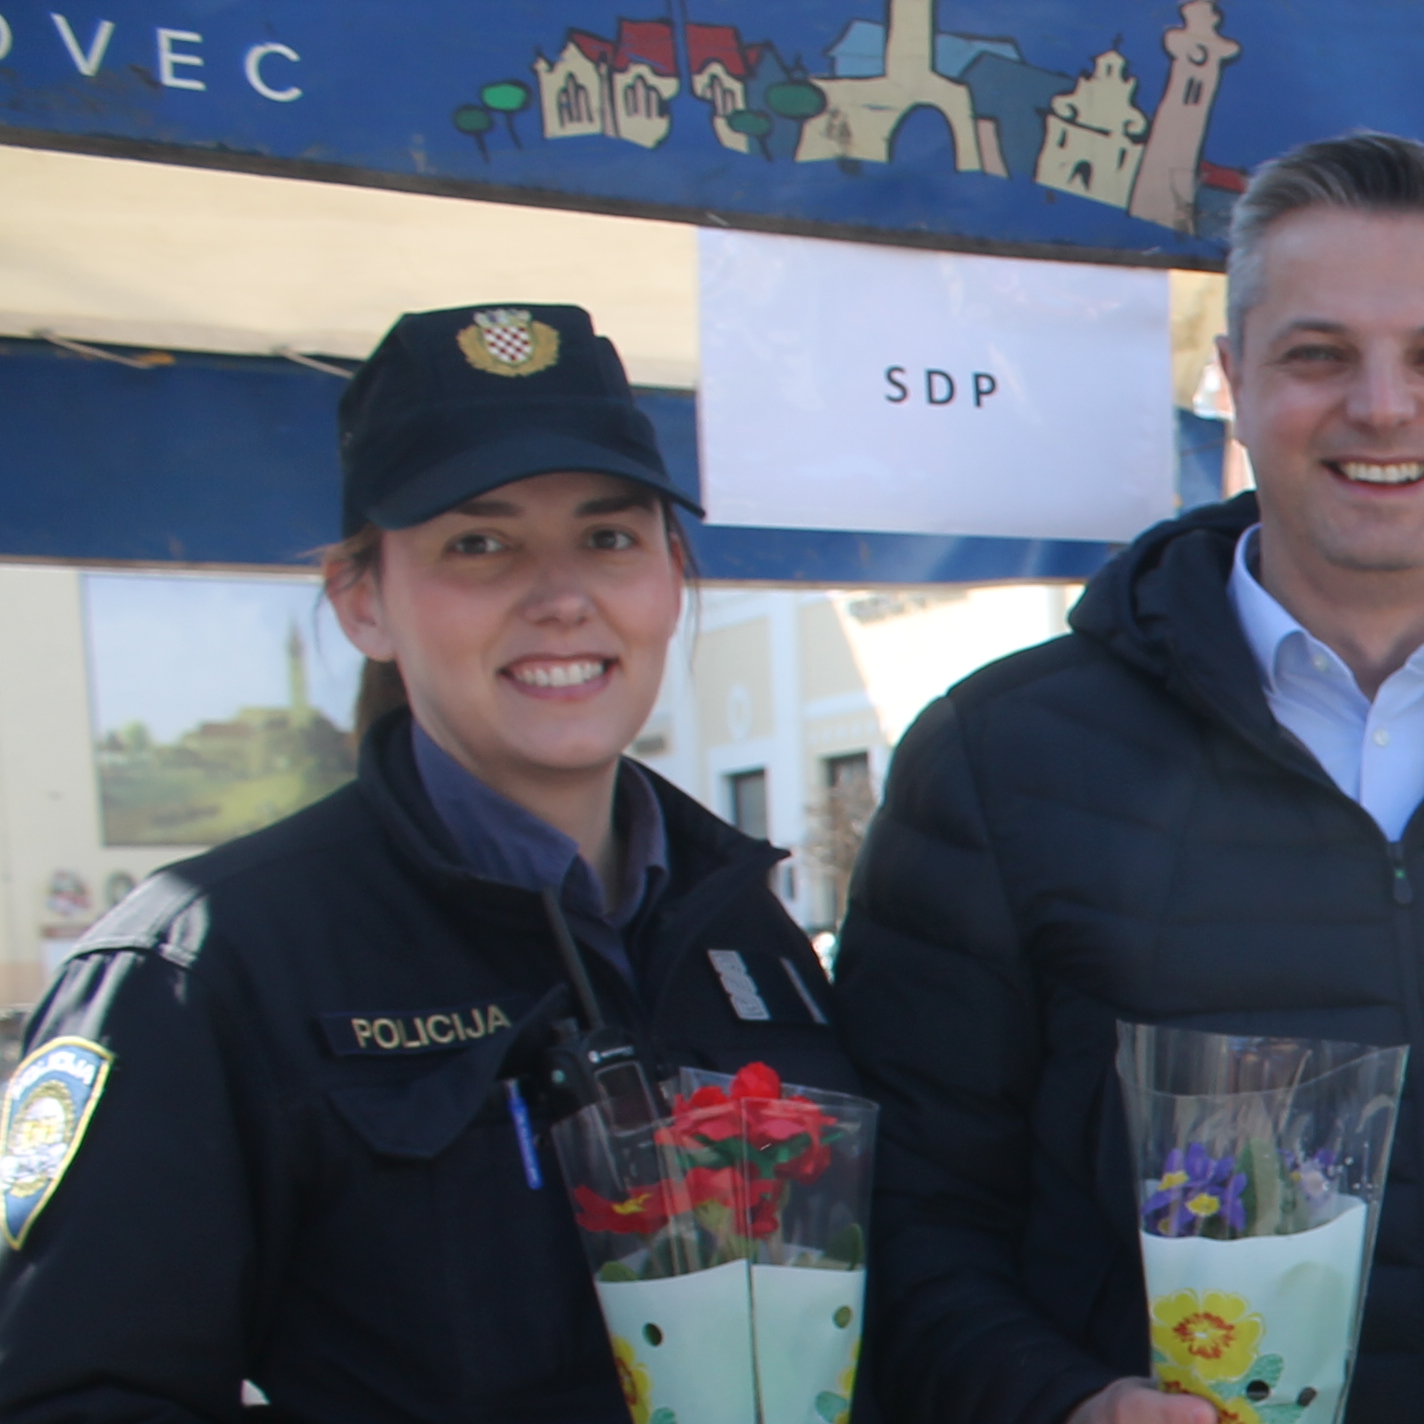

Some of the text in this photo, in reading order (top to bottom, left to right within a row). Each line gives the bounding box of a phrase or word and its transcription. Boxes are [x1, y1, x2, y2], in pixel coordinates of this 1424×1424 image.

[0, 12, 302, 102] VEC
[885, 365, 997, 408] SDP
[351, 1004, 512, 1049] POLICIJA
